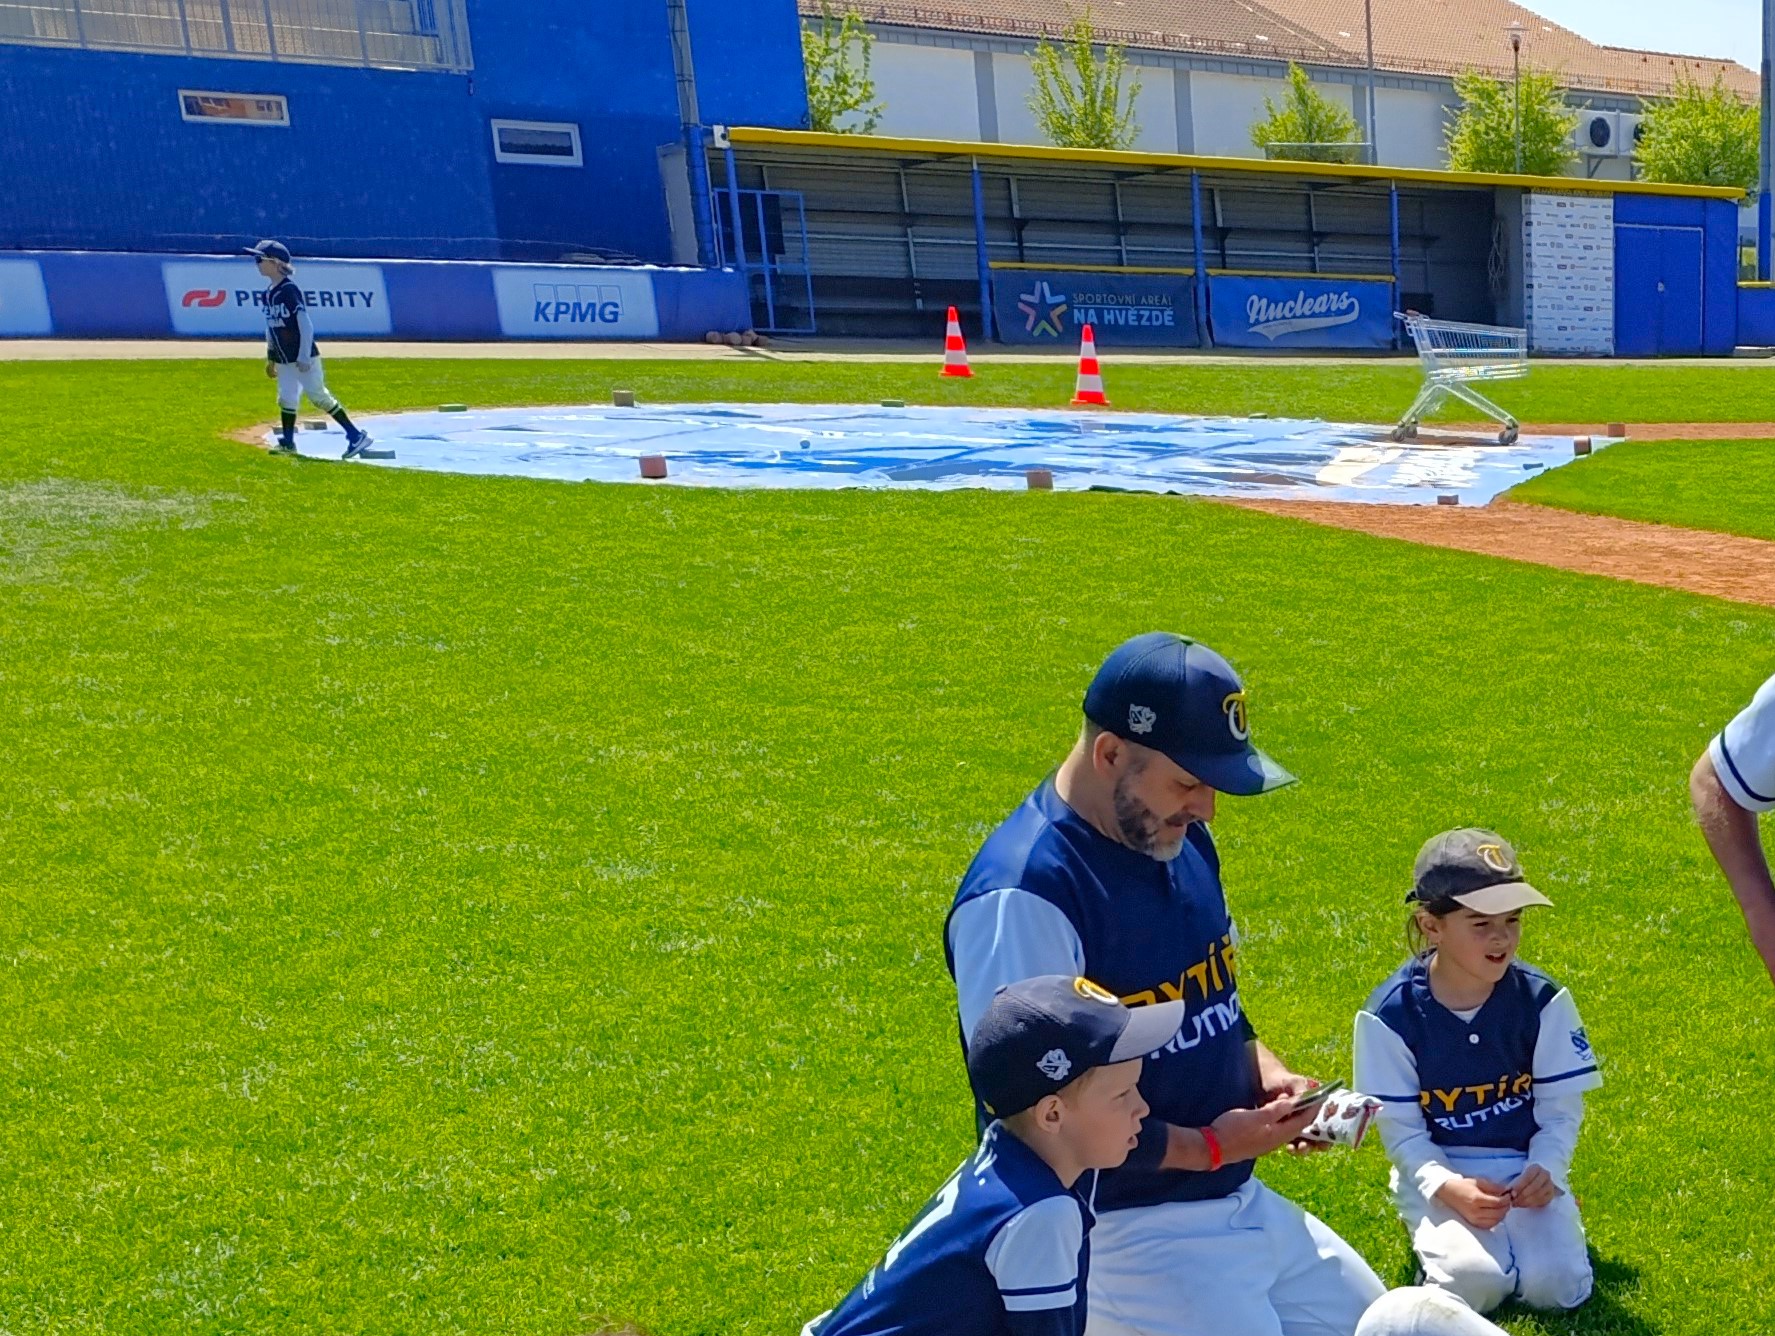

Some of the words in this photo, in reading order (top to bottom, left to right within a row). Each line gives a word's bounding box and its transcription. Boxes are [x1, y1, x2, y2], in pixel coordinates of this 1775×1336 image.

[1073, 293, 1136, 305] SPORTOVNÍ
[1140, 294, 1172, 306] AREÁL
[1246, 290, 1350, 324] Nuclears
[534, 301, 620, 323] KPMG
[1073, 308, 1098, 325] NA
[1103, 308, 1175, 326] HVĚZDĚ
